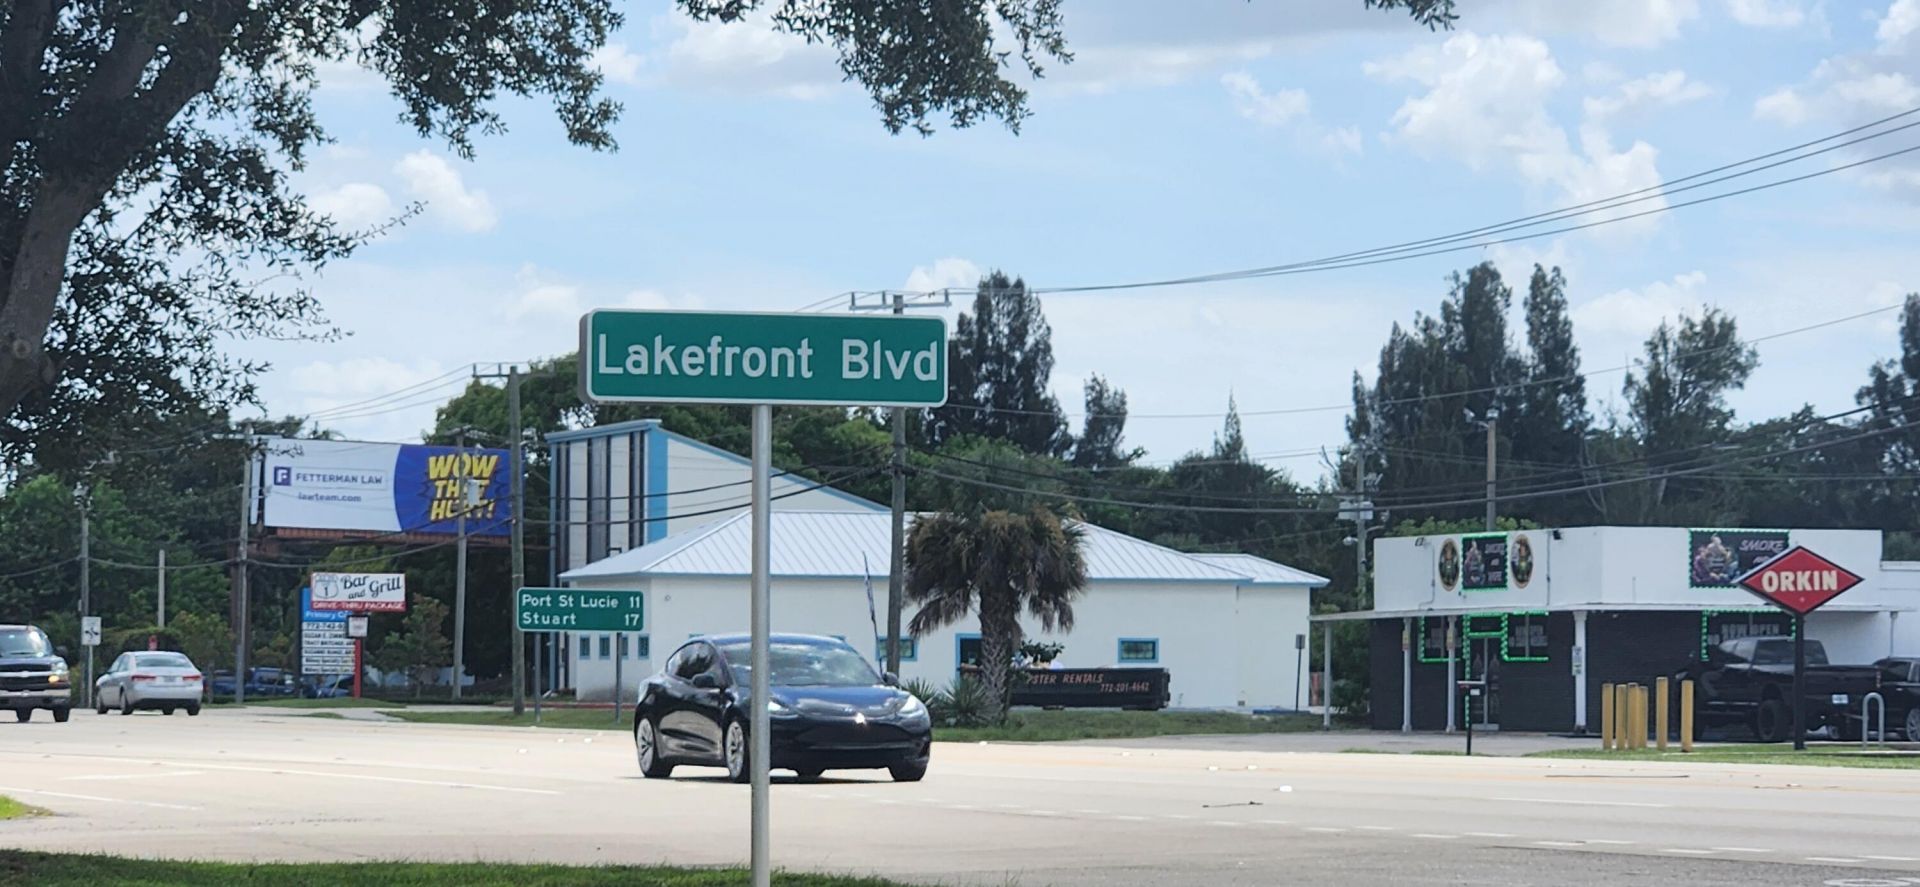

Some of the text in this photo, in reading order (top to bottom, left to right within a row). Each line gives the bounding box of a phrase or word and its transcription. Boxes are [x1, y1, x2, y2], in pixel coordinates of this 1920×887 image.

[597, 333, 938, 381] Lakefront Blvd
[429, 453, 498, 479] WOW
[296, 473, 383, 484] FETTERMAN LAW
[298, 492, 362, 502] lawteam.com
[1739, 539, 1785, 554] SMOKE
[341, 574, 402, 600] Bar and Grill
[1761, 570, 1838, 593] ORKIN
[364, 602, 404, 610] PACKAGE
[521, 594, 640, 608] Port St Lucie 11
[522, 612, 640, 626] Stuart 17
[1062, 673, 1104, 684] RENTALS
